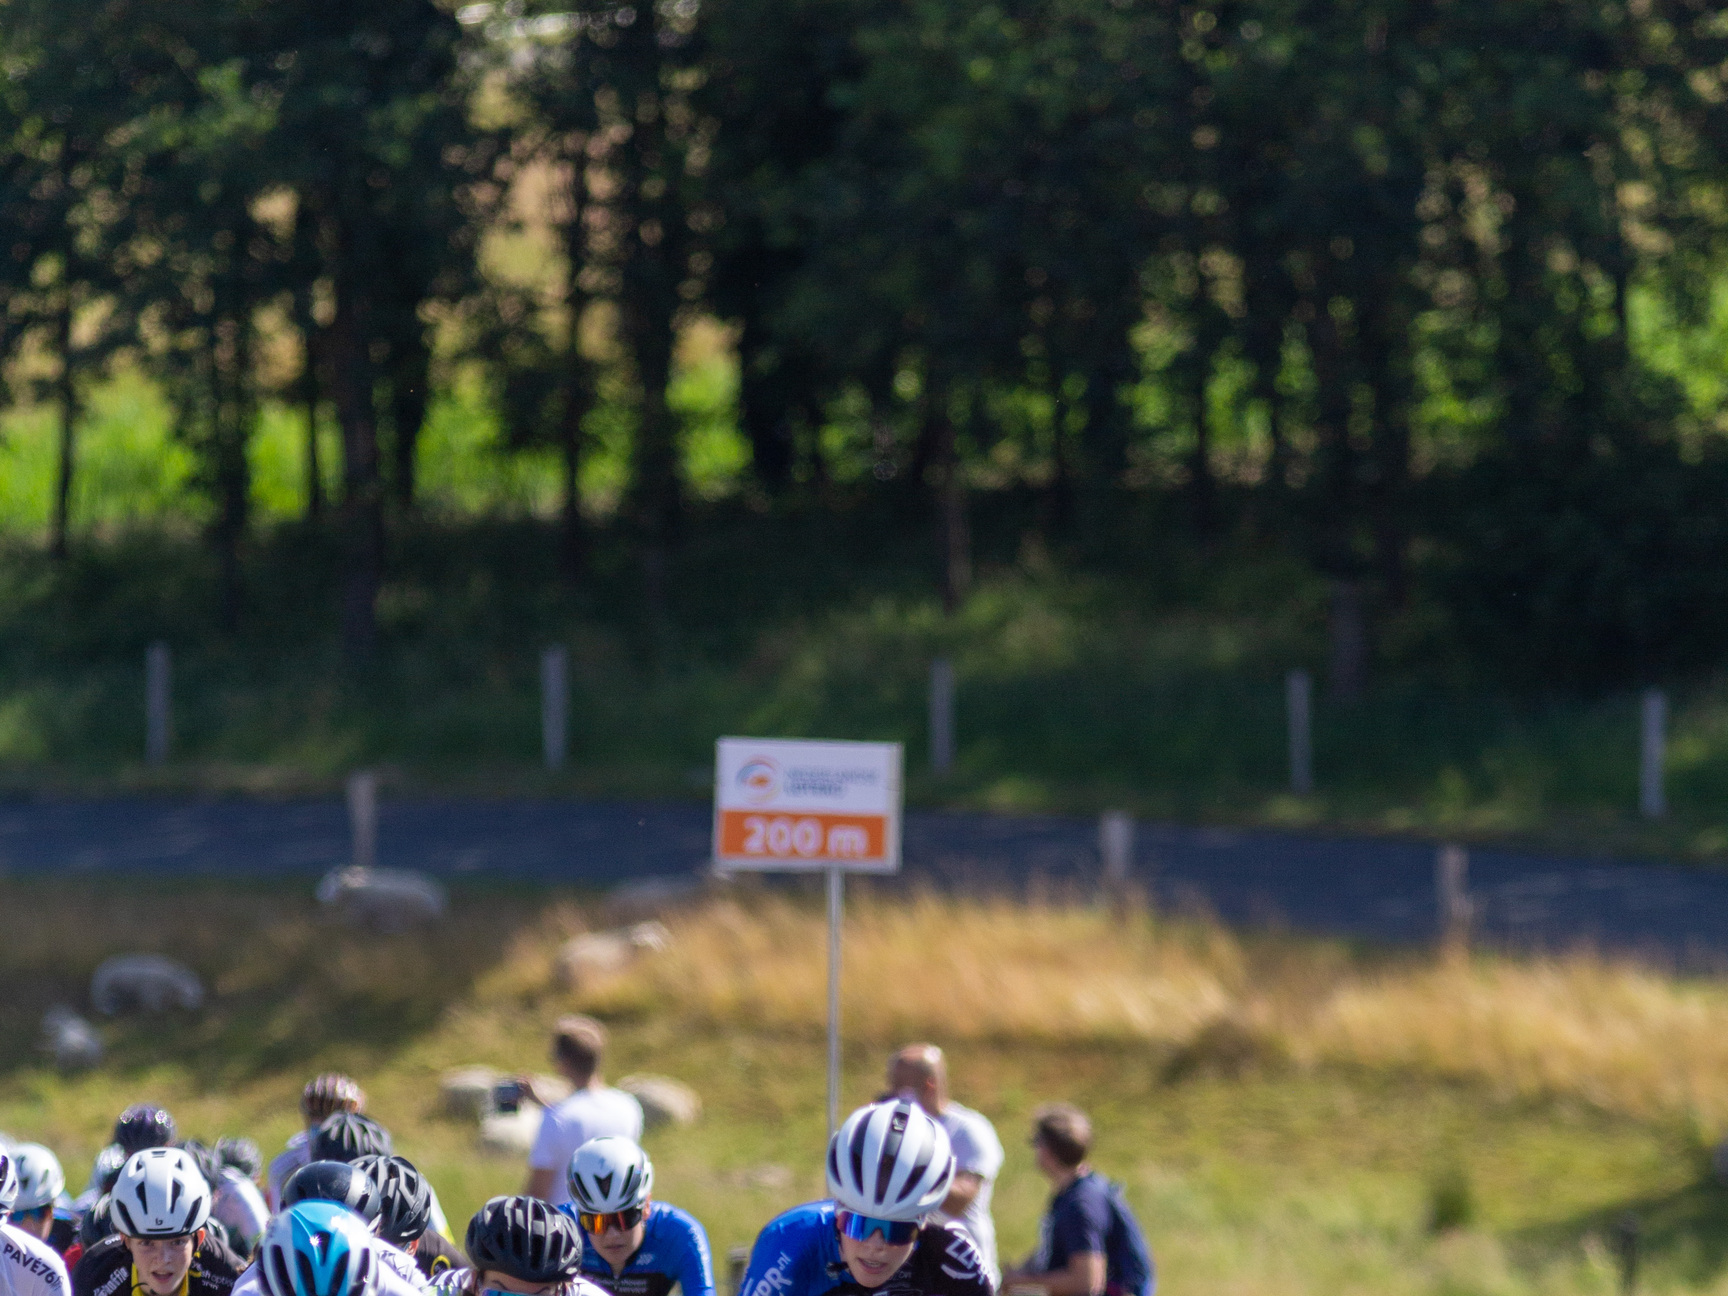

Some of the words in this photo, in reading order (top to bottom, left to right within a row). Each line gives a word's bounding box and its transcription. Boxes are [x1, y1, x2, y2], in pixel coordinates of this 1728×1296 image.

[744, 816, 823, 858] 200
[828, 825, 868, 858] m
[3, 1243, 57, 1284] PAVÉ76
